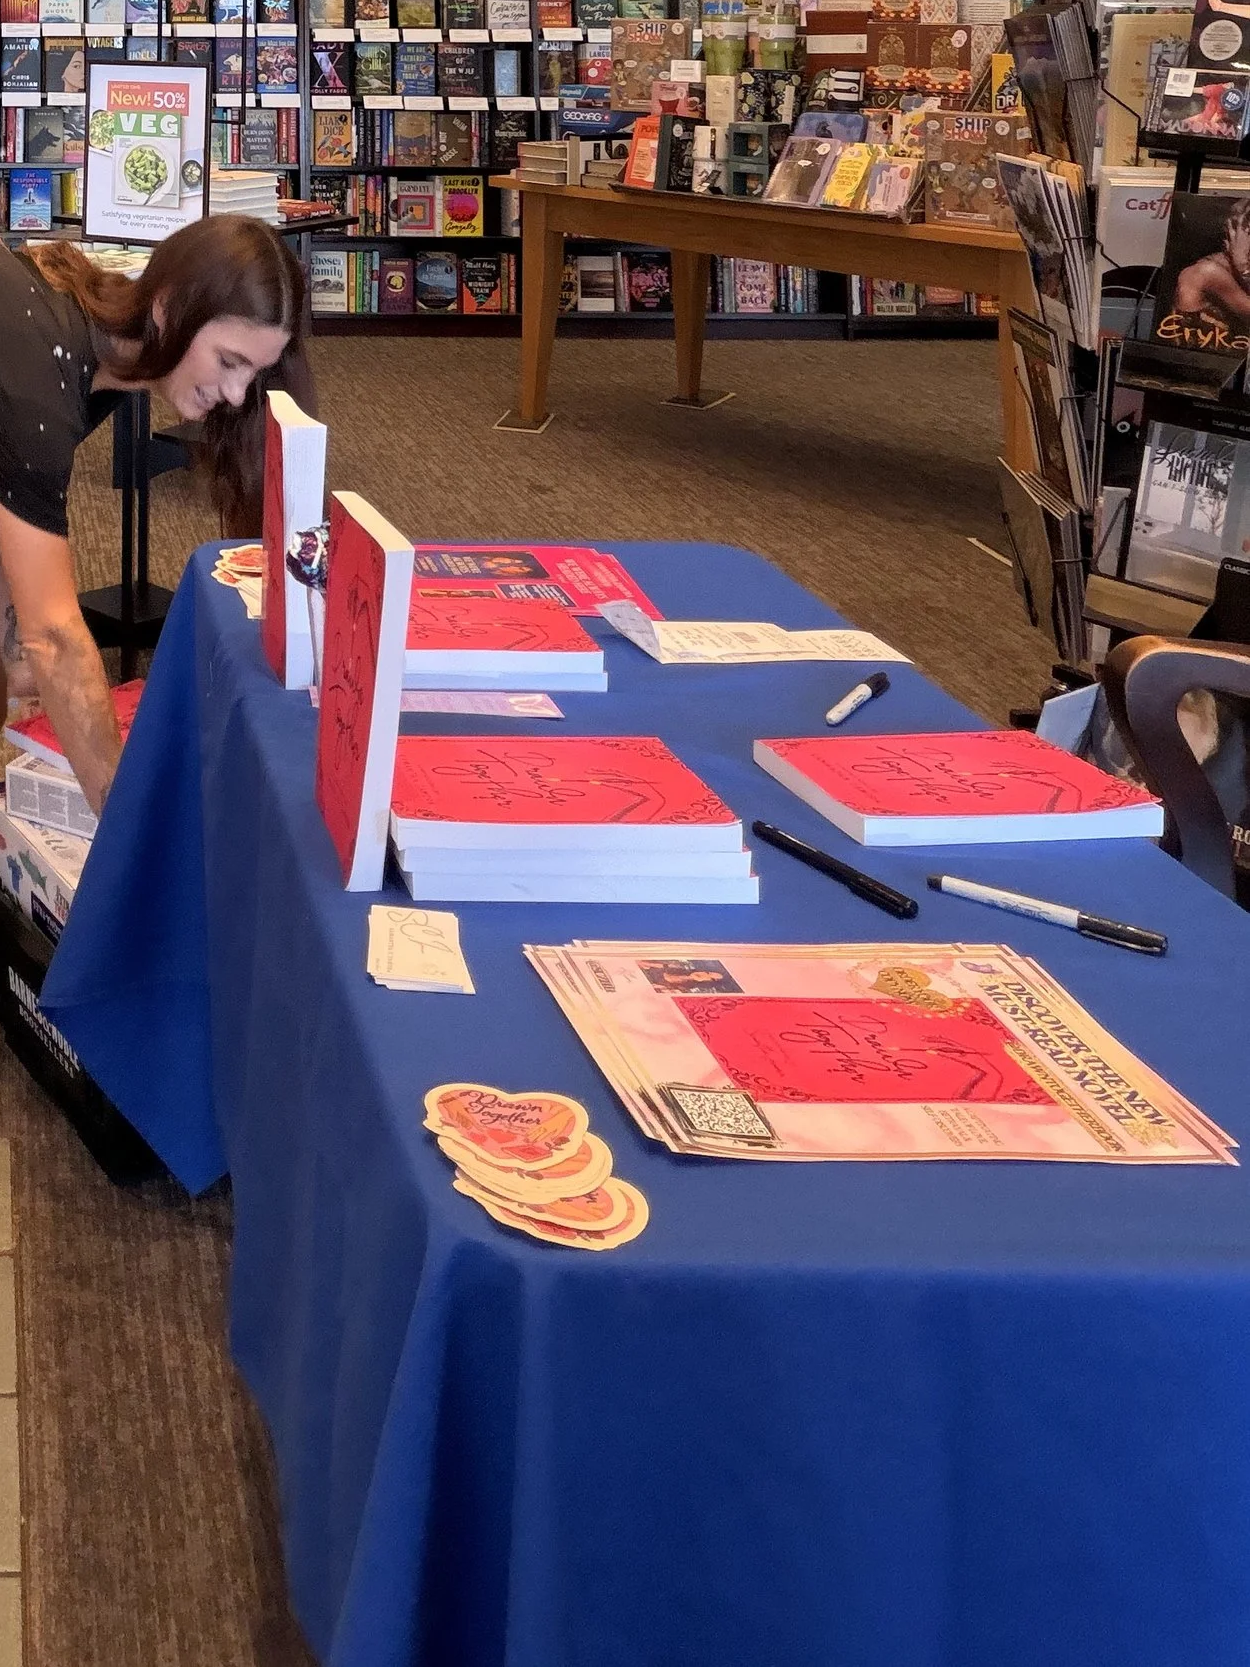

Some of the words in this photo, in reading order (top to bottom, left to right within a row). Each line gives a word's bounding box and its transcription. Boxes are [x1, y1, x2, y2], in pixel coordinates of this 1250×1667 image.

[637, 22, 668, 34] SHIP
[110, 90, 151, 107] New!
[119, 112, 179, 135] VEG
[563, 110, 602, 122] GEOMAG
[955, 117, 992, 129] SHIP
[101, 210, 132, 221] Satisfying
[132, 212, 165, 222] vegetarian
[1082, 1054, 1128, 1091] THE
[1119, 1085, 1176, 1129] NEW
[459, 1089, 544, 1114] Drawn
[464, 1103, 542, 1126] Together
